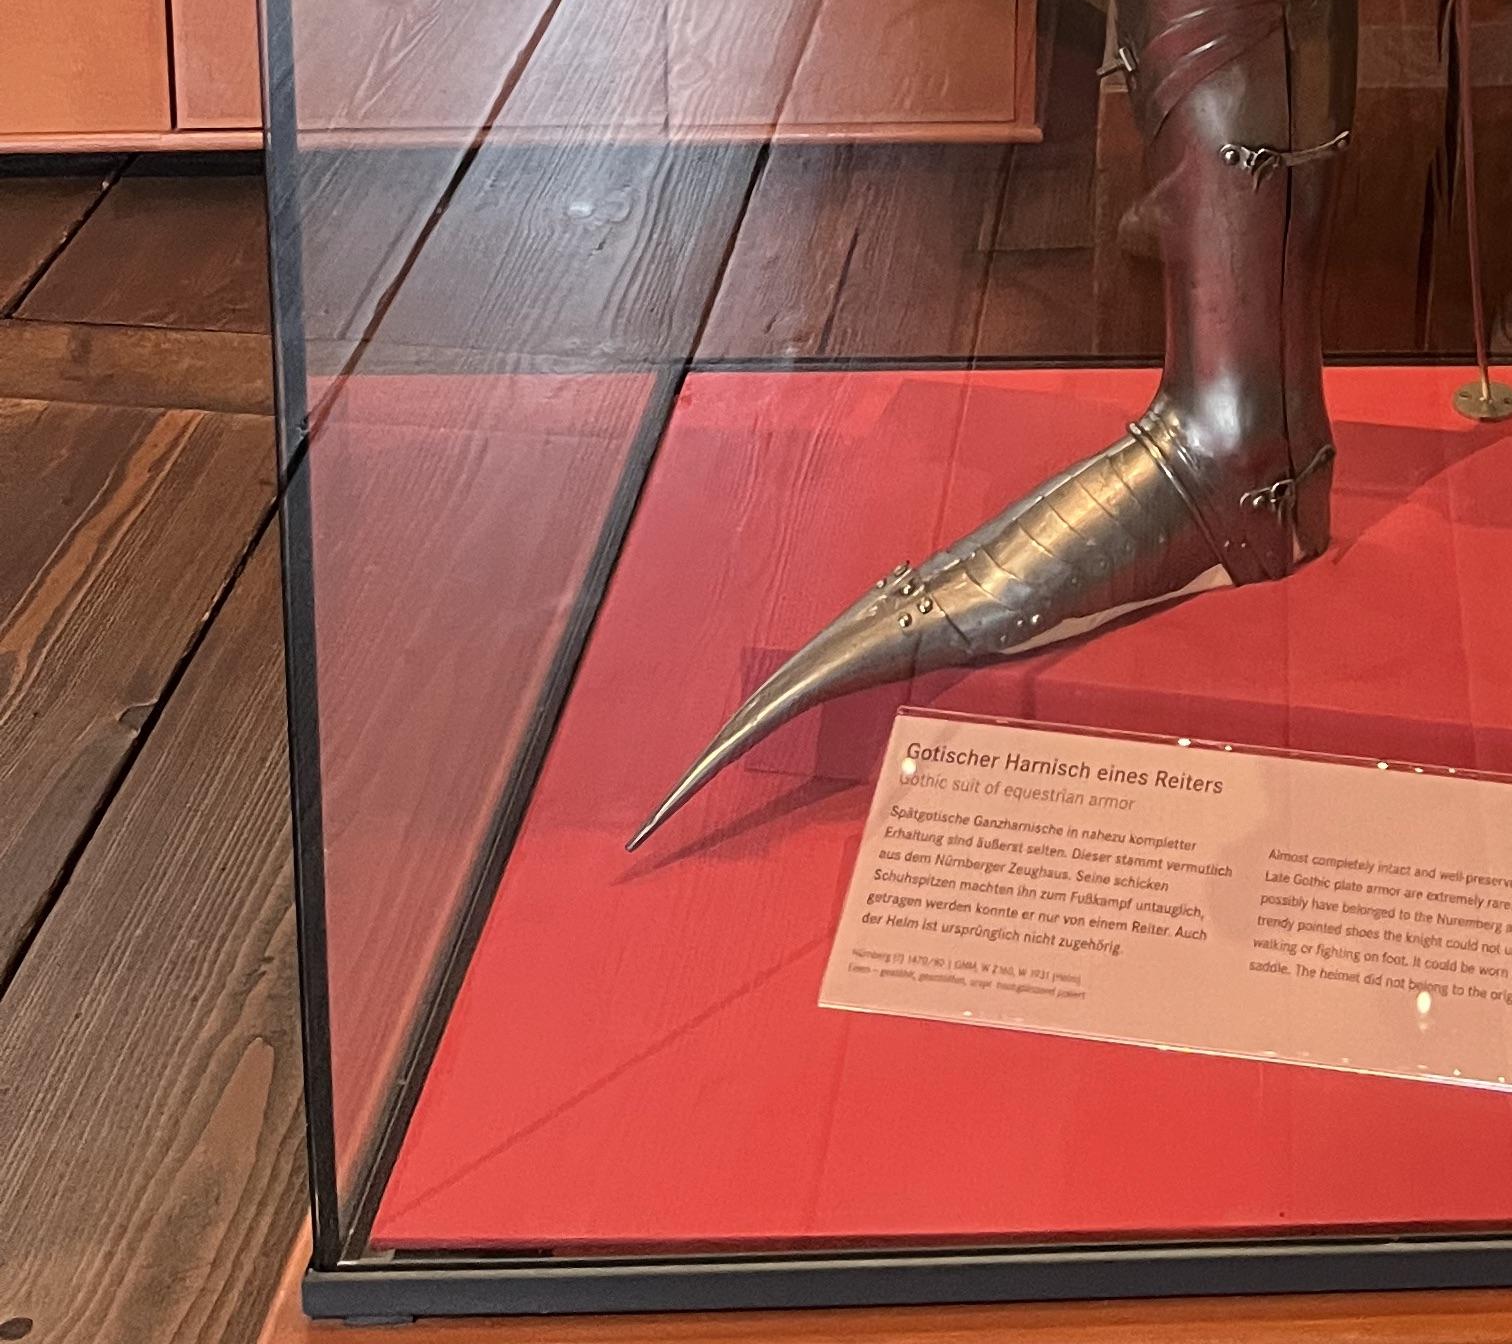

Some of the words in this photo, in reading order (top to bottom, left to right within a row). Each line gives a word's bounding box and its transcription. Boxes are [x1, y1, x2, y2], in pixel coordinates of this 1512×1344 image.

[906, 742, 1000, 768] Gotischer
[1004, 752, 1090, 778] Harnisch
[1096, 764, 1148, 785] eines
[1154, 769, 1223, 793] Reiters
[951, 777, 980, 793] suit
[983, 780, 1001, 795] of
[1003, 785, 1084, 805] equestrian
[1088, 795, 1135, 810] armor
[889, 804, 970, 825] Spätgotische
[973, 814, 1063, 836] Ganzharnische
[1066, 825, 1078, 838] in
[1081, 828, 1126, 843] nahezu
[1128, 833, 1196, 851] kompletter
[878, 849, 901, 860] aus
[904, 850, 931, 863] dem
[934, 853, 1005, 874] Nürnberger
[1075, 869, 1110, 884] Seine
[1113, 875, 1168, 892] schicken
[883, 825, 944, 847] Erhaltung
[946, 834, 974, 847] sind
[976, 836, 1023, 853] äußerst
[1071, 847, 1112, 862] Dieser
[1114, 854, 1163, 869] stammt
[1166, 860, 1232, 877] vermutlich
[1268, 848, 1308, 864] Almost
[1311, 856, 1374, 874] completely
[1377, 863, 1411, 876] intact
[1413, 867, 1436, 879] and
[873, 868, 956, 889] Schuhspitzen
[959, 880, 1013, 895] machten
[1016, 884, 1036, 898] ihn
[1039, 890, 1066, 901] zum
[1069, 891, 1133, 911] Fußkampf
[1264, 870, 1290, 883] Late
[1292, 873, 1330, 888] Gothic
[1333, 879, 1363, 892] plate
[1366, 884, 1401, 896] armor
[1403, 889, 1423, 899] are
[1426, 891, 1484, 909] extremely
[861, 911, 883, 924] der
[885, 914, 918, 928] Helm
[921, 918, 937, 931] ist
[941, 923, 1020, 941] ursprünglich
[1023, 930, 1055, 945] nicht
[866, 892, 921, 908] getragen
[925, 898, 971, 912] werden
[975, 902, 1018, 918] konnte
[1021, 911, 1035, 920] er
[1037, 912, 1060, 923] nur
[1062, 915, 1085, 926] von
[1088, 915, 1127, 930] einem
[1174, 925, 1207, 940] Auch
[1259, 894, 1308, 911] possibly
[1311, 897, 1338, 911] have
[1341, 901, 1395, 920] belonged
[1398, 908, 1410, 920] to
[1413, 911, 1433, 923] the
[1436, 912, 1502, 934] Nuremberg
[1257, 915, 1294, 931] trendy
[1296, 921, 1342, 935] pointed
[1345, 925, 1379, 939] shoes
[1383, 929, 1402, 942] the
[1405, 931, 1442, 948] knight
[1445, 938, 1478, 951] could
[1481, 943, 1500, 954] not
[1253, 938, 1297, 956] walking
[1300, 944, 1313, 954] or
[1315, 943, 1360, 963] fighting
[1363, 952, 1379, 962] on
[1412, 955, 1421, 967] It
[1424, 959, 1457, 972] could
[1460, 960, 1475, 974] be
[1479, 966, 1508, 978] worn
[1295, 963, 1316, 978] The
[1319, 967, 1360, 983] helmet
[1363, 973, 1383, 986] did
[1385, 977, 1405, 989] not
[1408, 977, 1448, 997] belong
[1451, 983, 1464, 995] to
[1467, 985, 1487, 998] the
